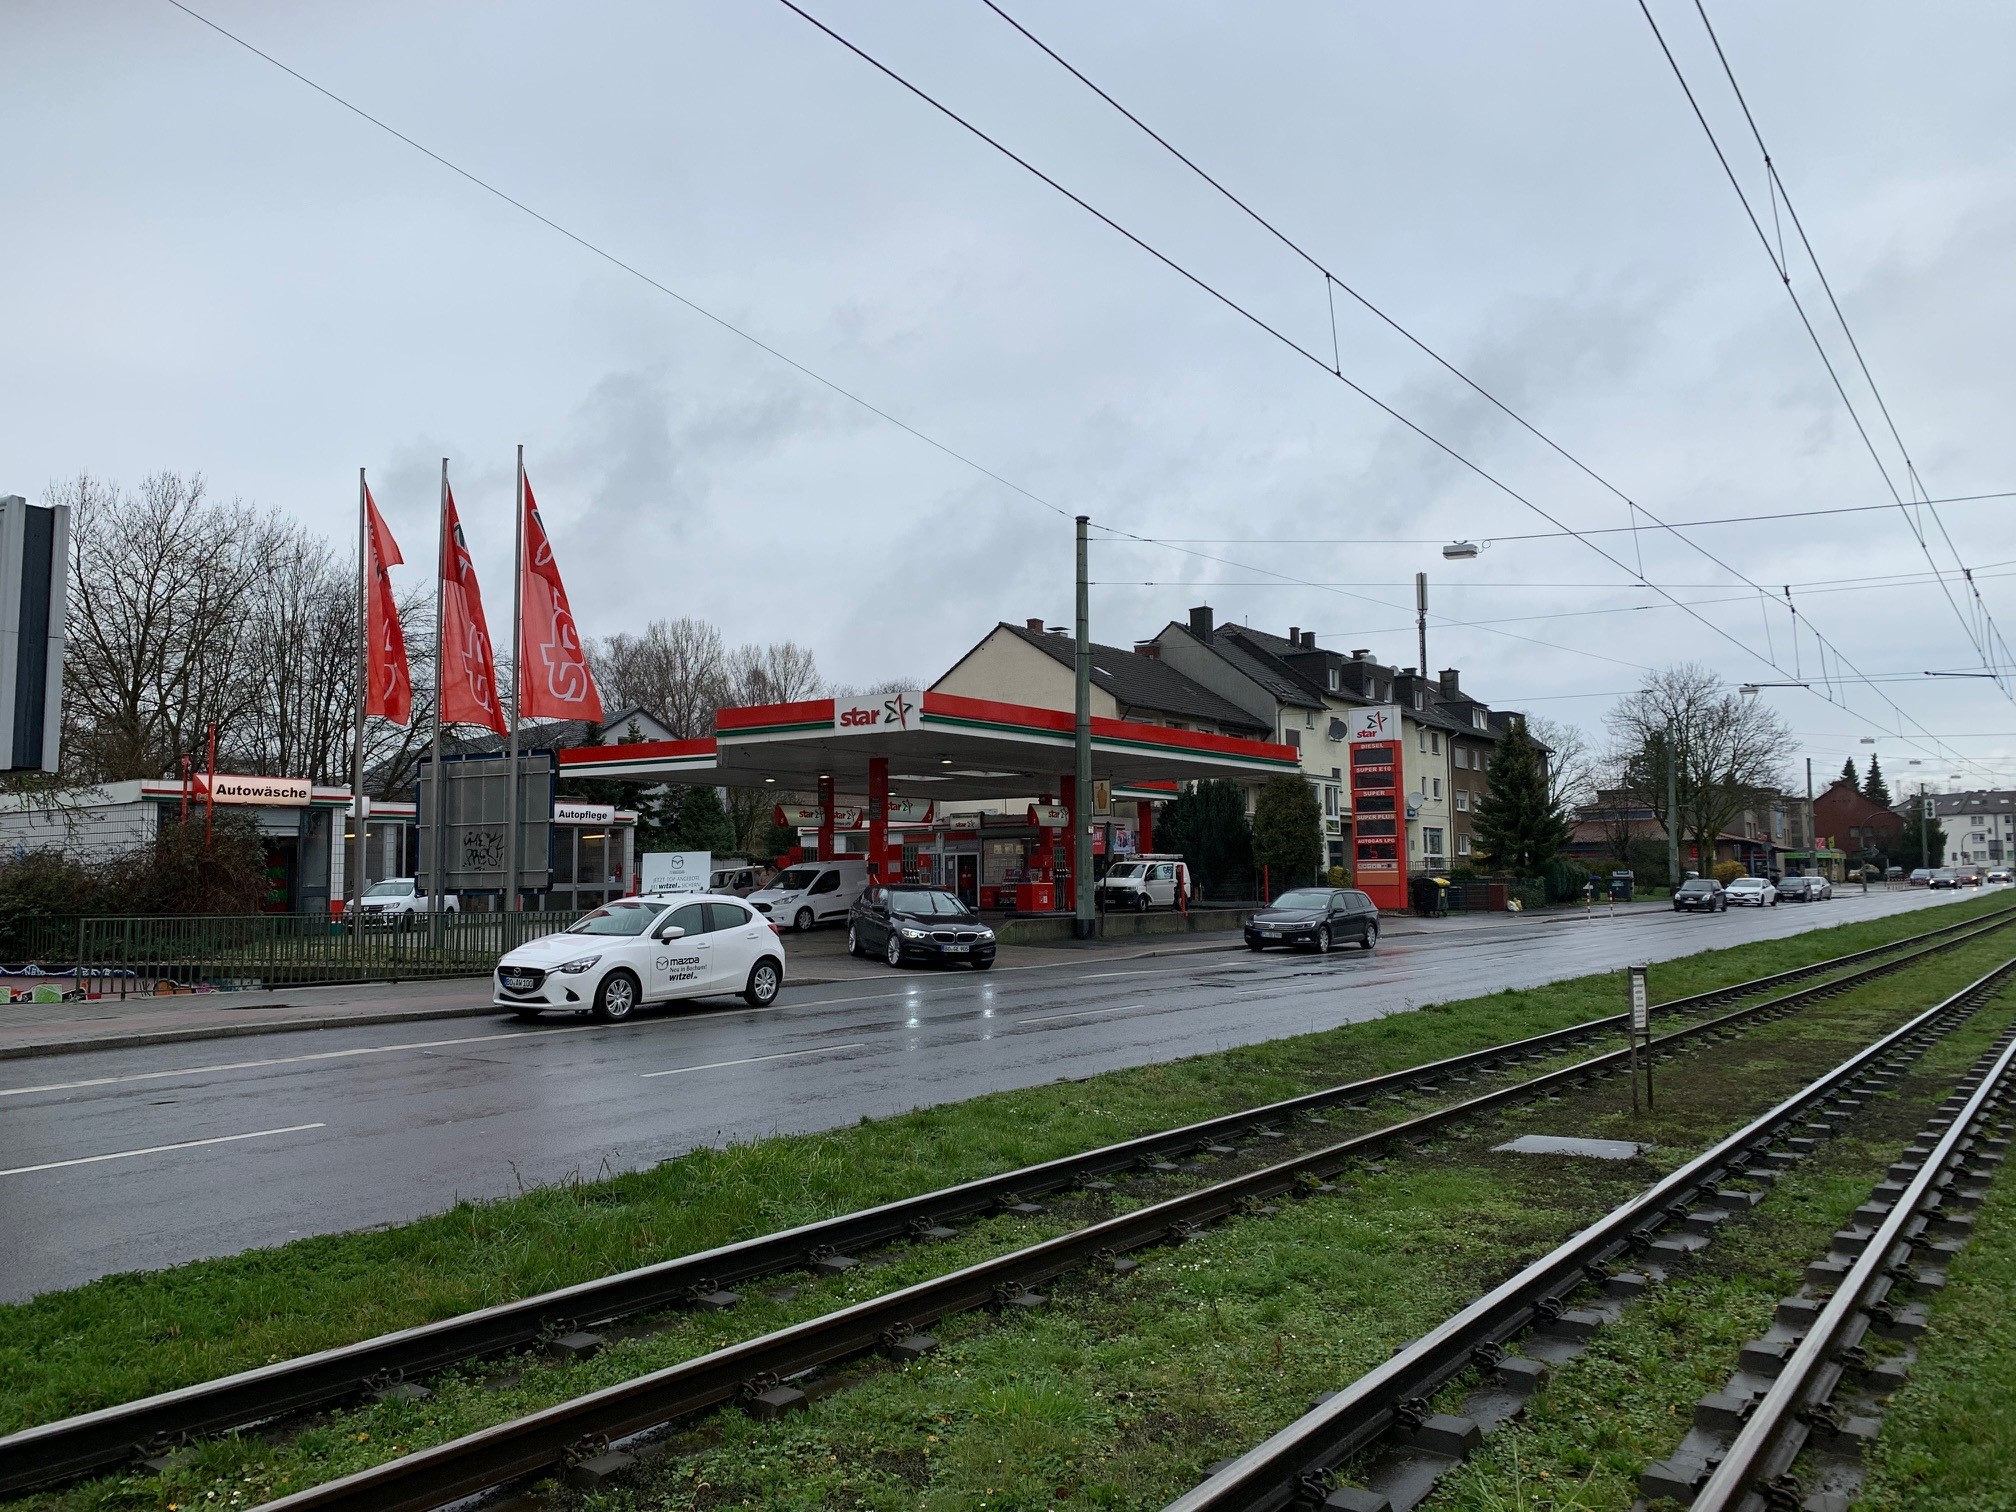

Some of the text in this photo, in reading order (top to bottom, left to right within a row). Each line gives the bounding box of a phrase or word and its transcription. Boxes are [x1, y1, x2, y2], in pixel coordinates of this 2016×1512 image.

[840, 706, 880, 727] star
[1356, 729, 1377, 739] star
[215, 783, 307, 799] Autowäsche
[558, 809, 608, 821] Autopflege
[799, 810, 814, 818] star
[1048, 810, 1060, 818] star
[670, 956, 700, 966] mazda
[686, 964, 707, 972] Bochum!
